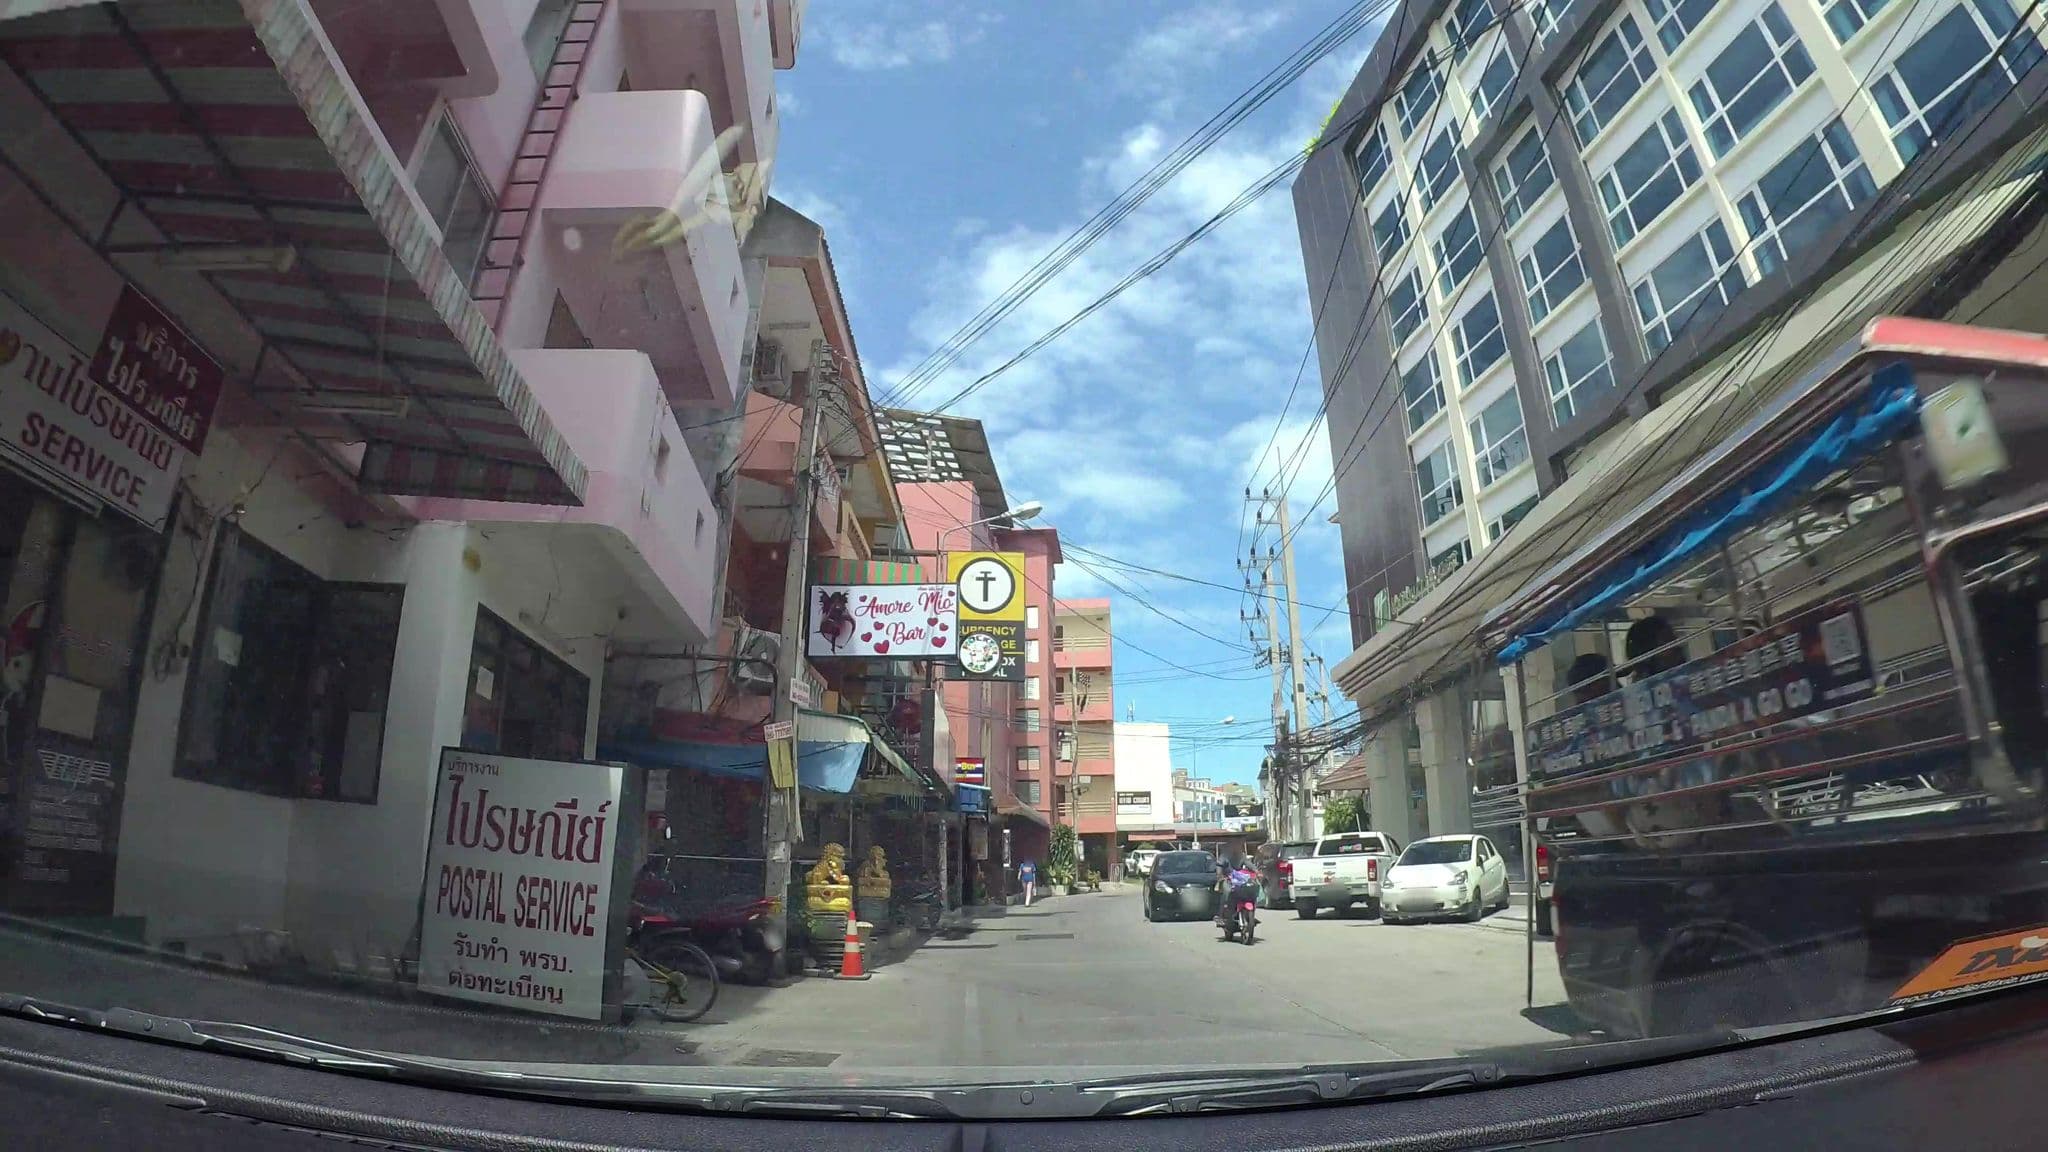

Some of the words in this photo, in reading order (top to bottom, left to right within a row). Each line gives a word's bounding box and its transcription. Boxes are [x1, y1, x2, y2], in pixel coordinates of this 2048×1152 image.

[136, 321, 199, 389] บริการ
[21, 411, 147, 508] SERVICE
[855, 596, 913, 619] Amore
[918, 590, 955, 615] Mio
[886, 622, 925, 645] Bar
[448, 757, 499, 776] บริการงาน
[446, 774, 612, 864] ไปรษณีย์
[437, 864, 506, 925] POSTAL
[513, 874, 598, 937] SERVICE
[453, 932, 508, 964] รับทำ
[519, 949, 574, 973] พรบ.
[449, 967, 564, 1004] ต่อทะเบียน
